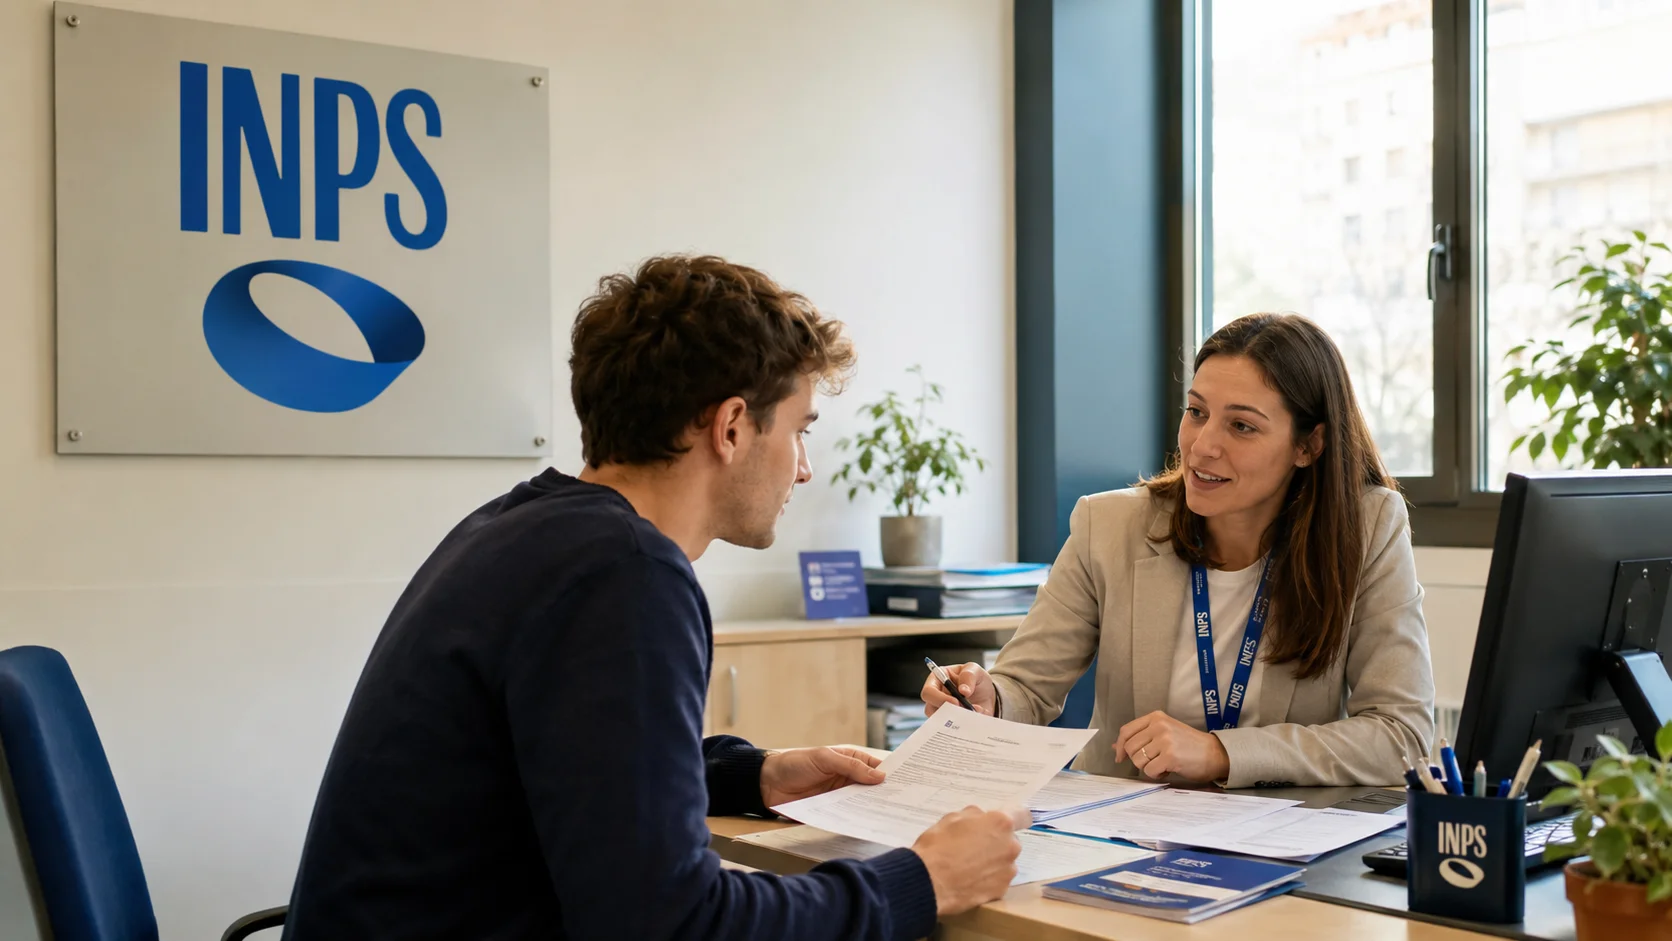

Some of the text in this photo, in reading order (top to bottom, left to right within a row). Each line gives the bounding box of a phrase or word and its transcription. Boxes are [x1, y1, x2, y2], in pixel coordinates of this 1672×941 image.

[180, 61, 448, 250] INPS
[1197, 611, 1209, 637] INPS
[1205, 690, 1218, 715] INPS
[1438, 821, 1488, 859] INPS
